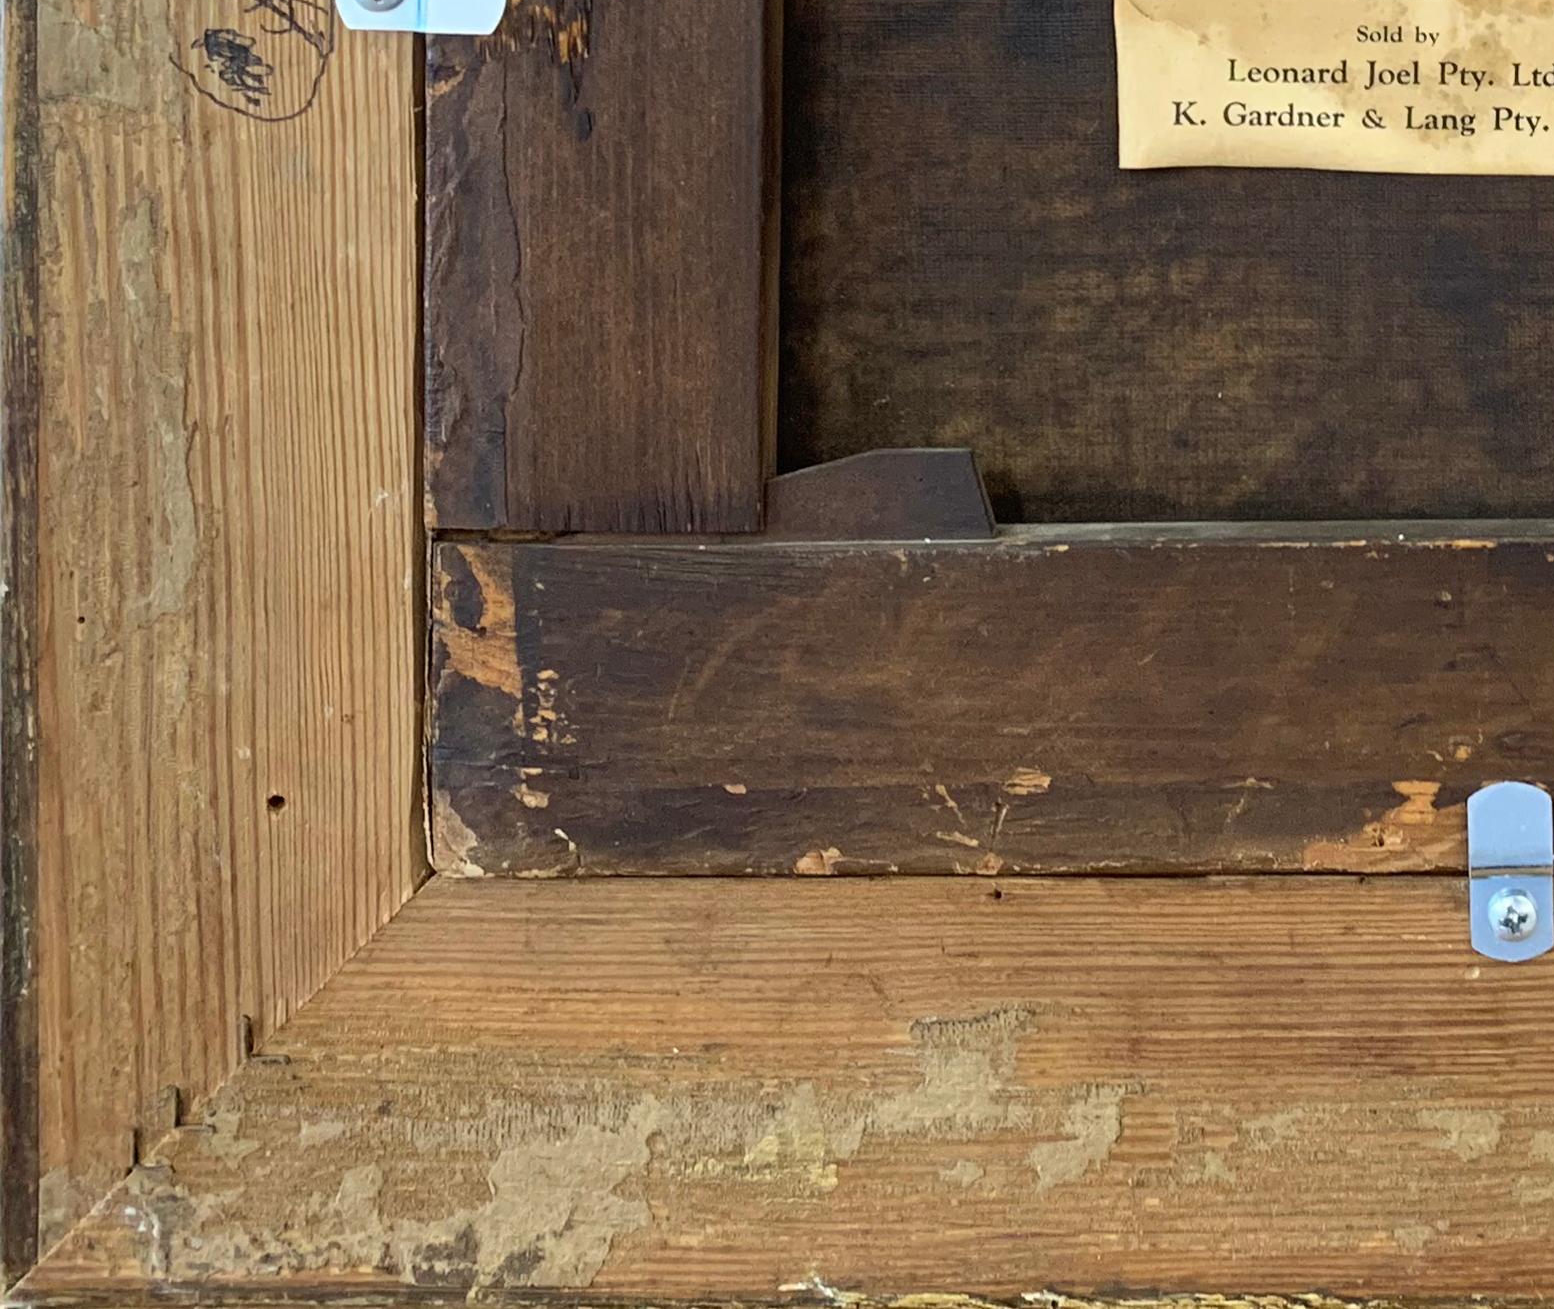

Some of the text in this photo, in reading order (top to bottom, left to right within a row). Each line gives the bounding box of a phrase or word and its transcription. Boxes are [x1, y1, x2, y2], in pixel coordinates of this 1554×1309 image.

[1355, 24, 1441, 48] Sold by
[1227, 58, 1349, 85] Leonard
[1363, 59, 1421, 91] Joel
[1437, 60, 1496, 92] Pty.
[1171, 100, 1208, 127] K.
[1222, 101, 1346, 129] Gardner
[1360, 107, 1387, 131] &
[1404, 105, 1477, 137] Lang
[1492, 106, 1551, 138] Pty.
